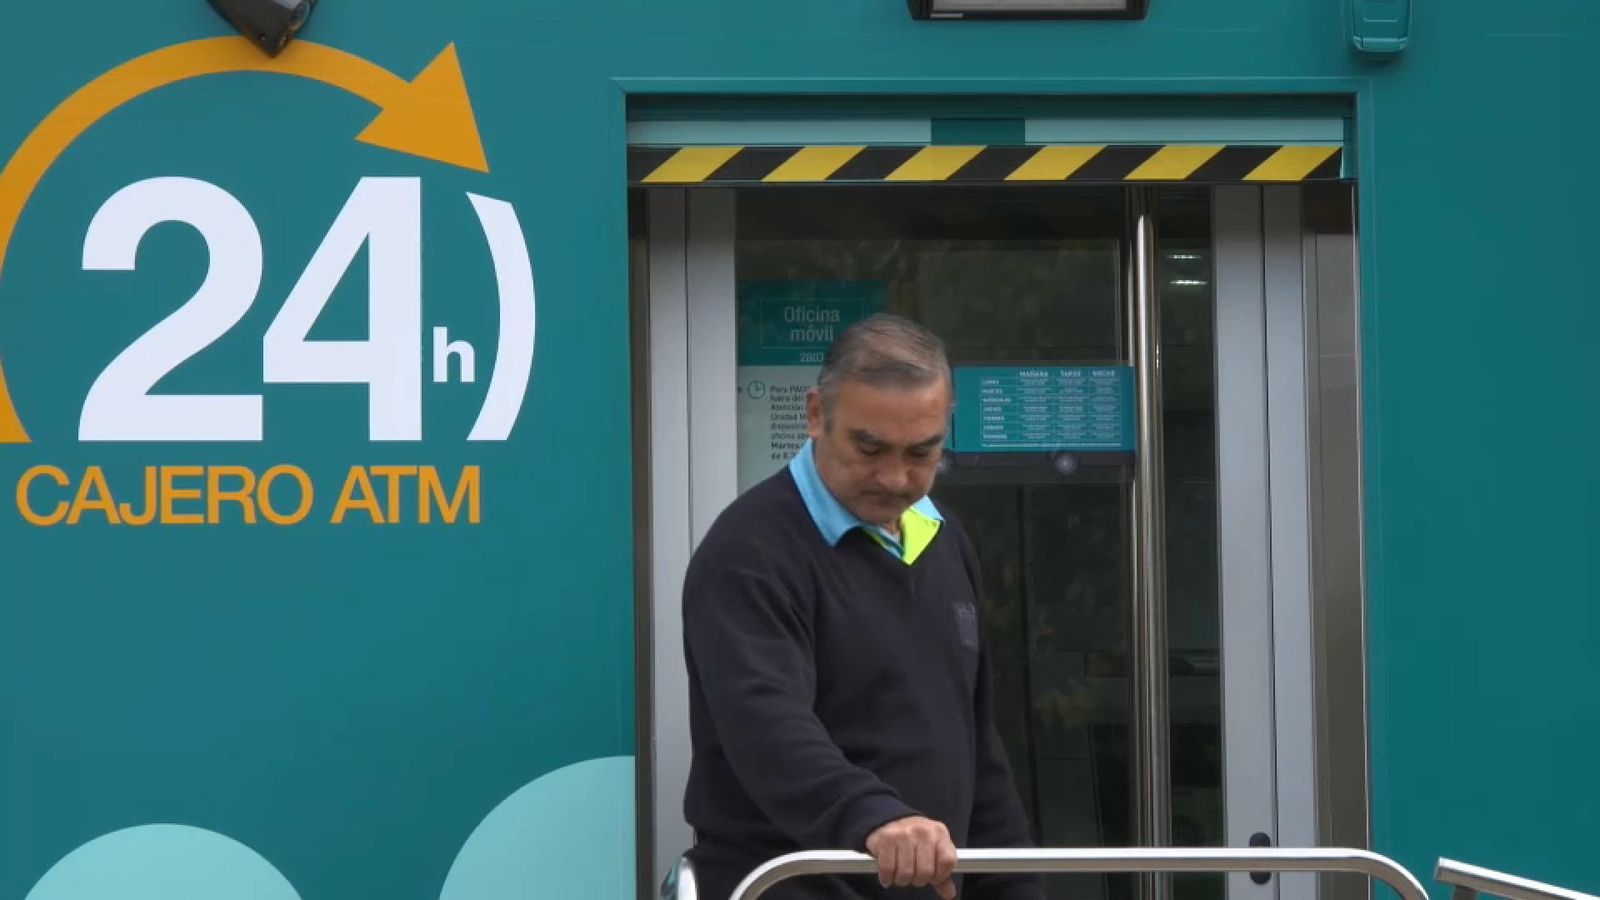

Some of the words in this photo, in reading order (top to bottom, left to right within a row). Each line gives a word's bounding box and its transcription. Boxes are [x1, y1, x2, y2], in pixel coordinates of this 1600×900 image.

[784, 306, 840, 323] Oficina
[790, 324, 834, 342] móvil
[16, 465, 314, 526] CAJERO
[330, 466, 481, 524] ATM
